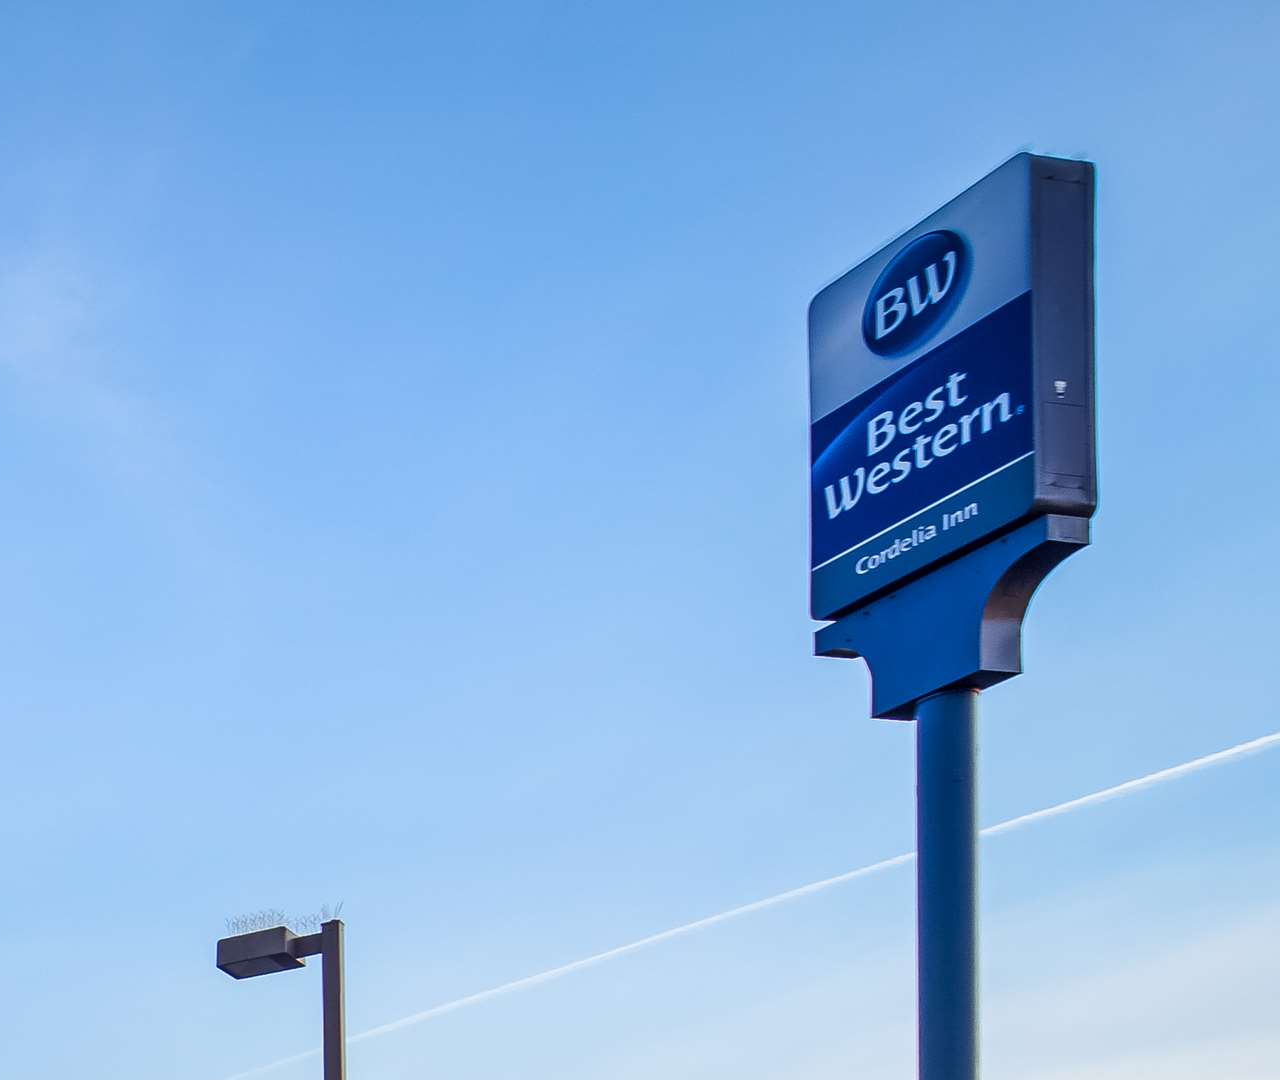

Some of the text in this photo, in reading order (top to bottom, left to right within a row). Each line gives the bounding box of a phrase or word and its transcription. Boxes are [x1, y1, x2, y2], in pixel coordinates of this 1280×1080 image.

[875, 251, 957, 340] BW
[824, 392, 1013, 520] Western
[867, 371, 968, 457] Best
[855, 502, 978, 575] Cordelia Inn
